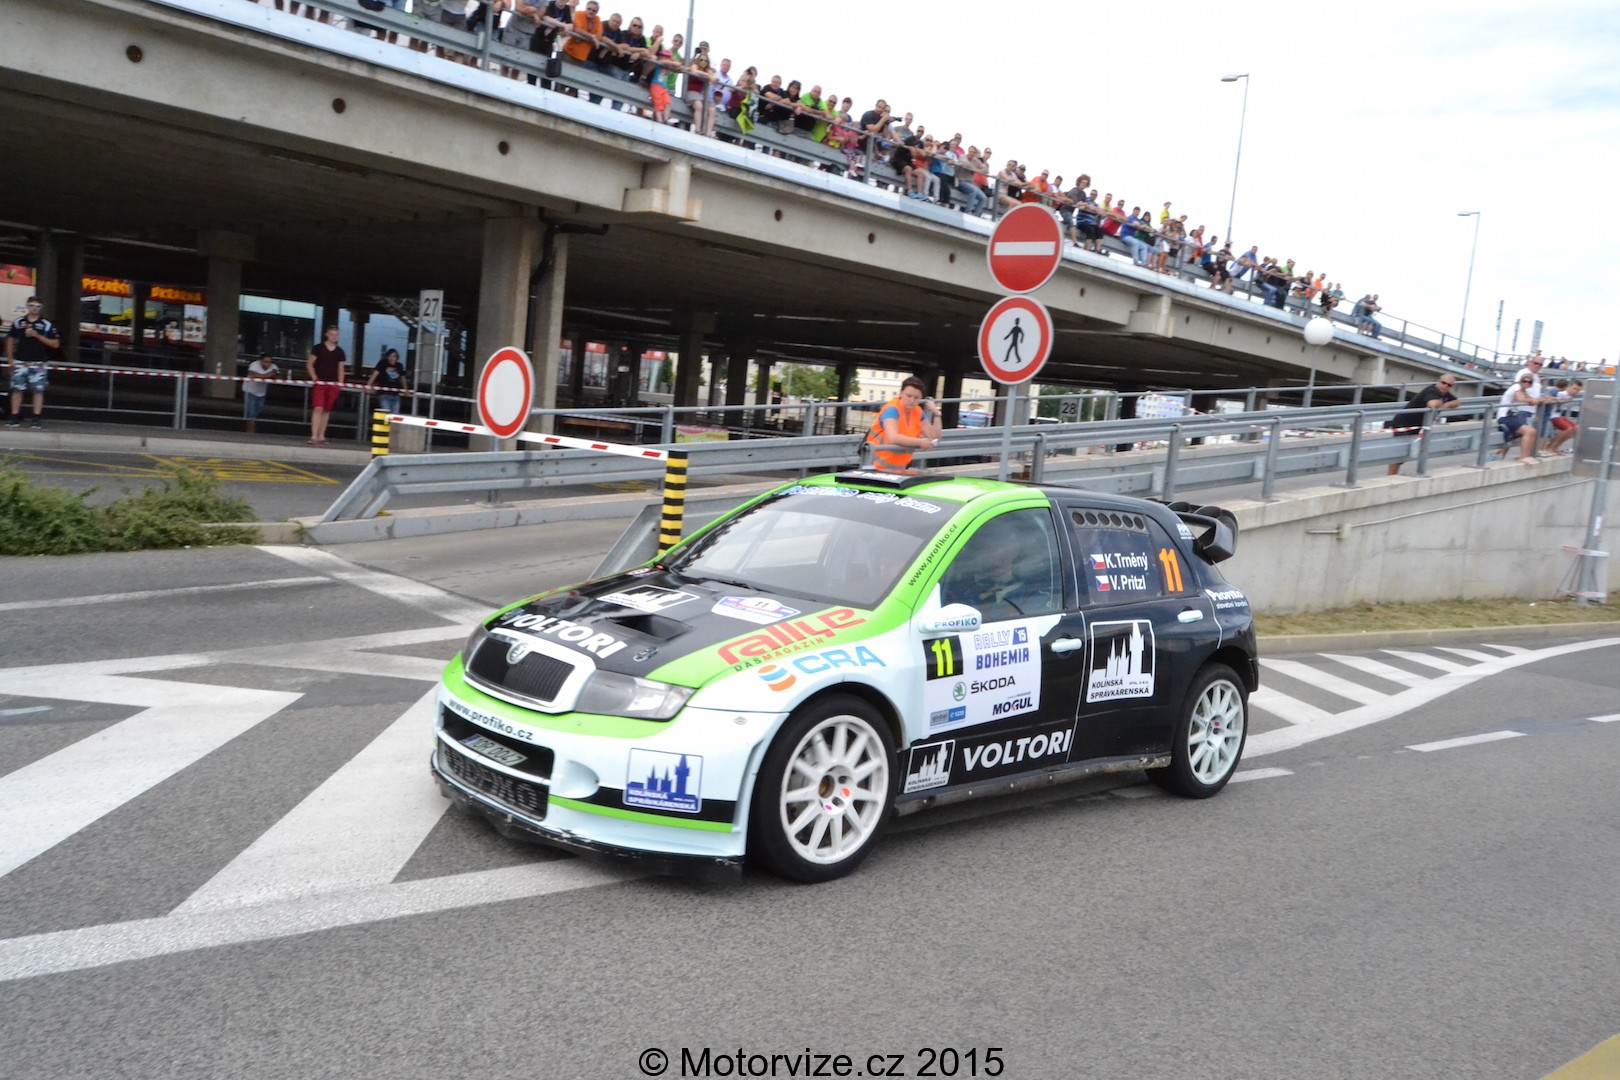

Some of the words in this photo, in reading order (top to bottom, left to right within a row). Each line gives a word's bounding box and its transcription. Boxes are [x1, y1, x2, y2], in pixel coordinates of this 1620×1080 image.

[423, 298, 439, 316] 27
[1062, 402, 1077, 415] 28
[908, 523, 958, 587] www.profiko.cz
[1158, 548, 1184, 593] 11
[502, 613, 628, 659] VOLTORI
[974, 629, 1010, 651] RALLY
[792, 646, 887, 675] CRA
[931, 638, 954, 677] 11
[976, 647, 1030, 670] BOHEMIA
[970, 674, 1016, 694] ŠKODA
[448, 699, 535, 741] www.profiko.cz
[992, 697, 1033, 716] MOGUL
[963, 729, 1073, 772] VOLTORI
